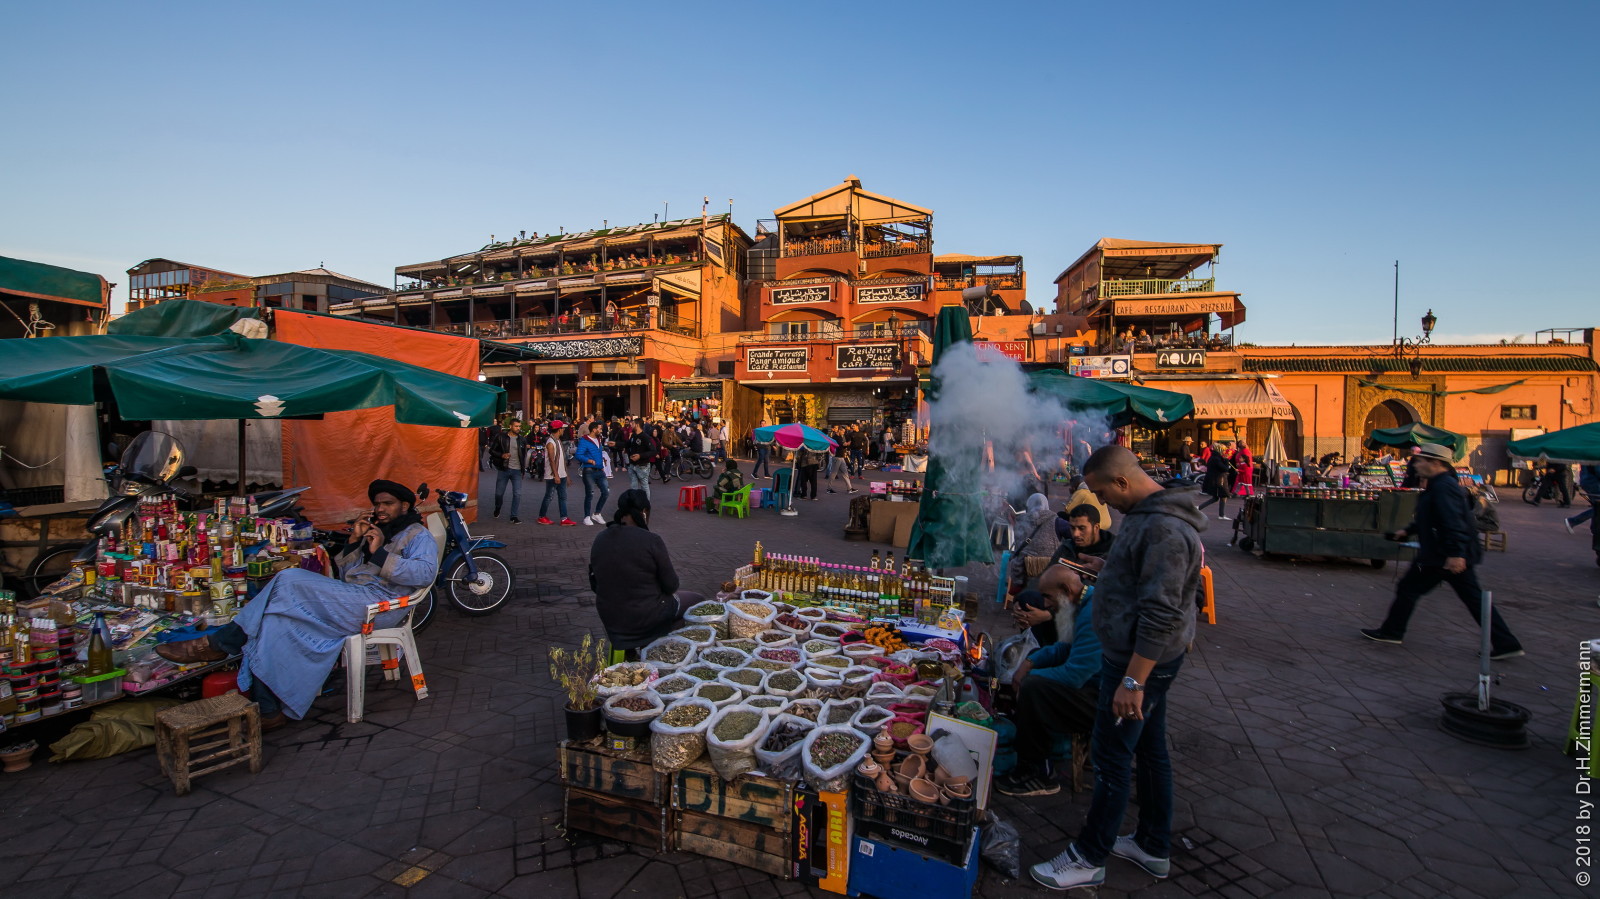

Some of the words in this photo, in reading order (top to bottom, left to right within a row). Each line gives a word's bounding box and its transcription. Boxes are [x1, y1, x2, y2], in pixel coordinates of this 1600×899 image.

[1144, 303, 1189, 314] RESTAURANT
[1200, 302, 1233, 312] PIZZERIA
[978, 343, 1004, 353] CINQ
[1004, 342, 1025, 351] SENS
[750, 350, 774, 358] Grande
[1158, 352, 1204, 366] AQUA
[1219, 407, 1267, 416] RESTAURANT
[1273, 406, 1294, 417] AQUA
[890, 827, 930, 847] Avocados
